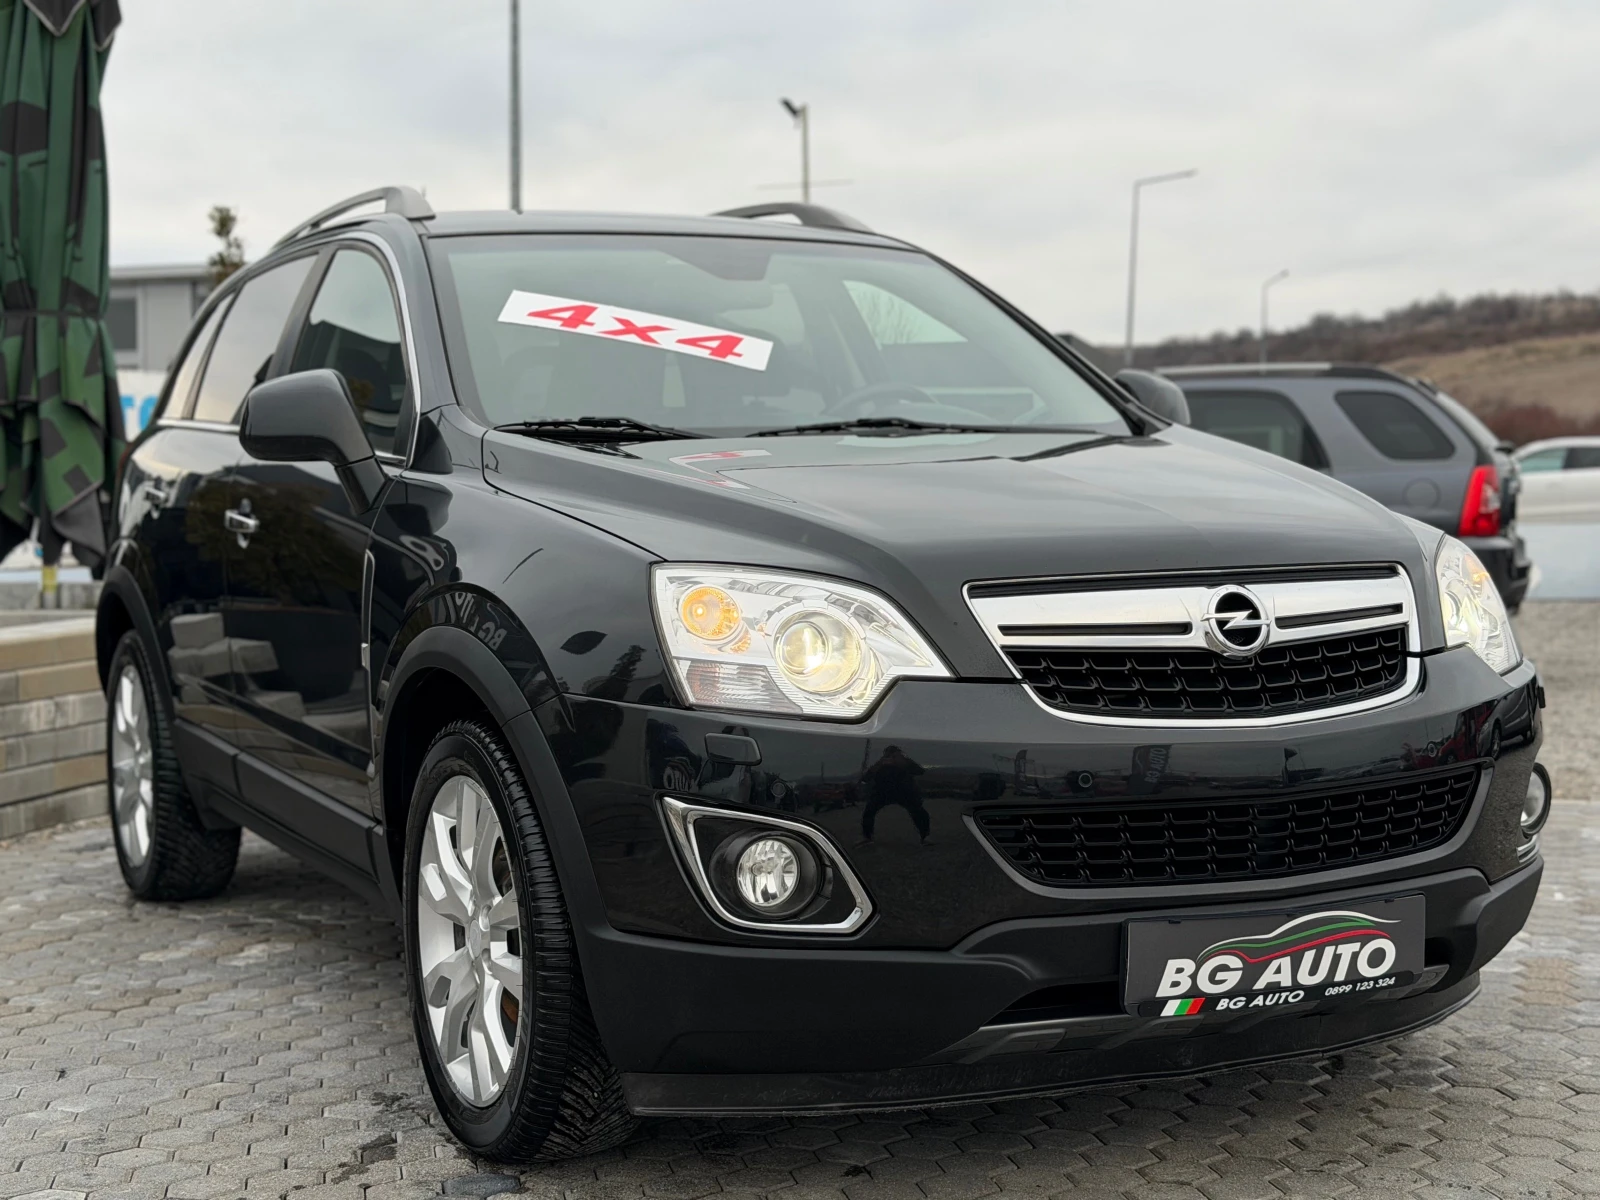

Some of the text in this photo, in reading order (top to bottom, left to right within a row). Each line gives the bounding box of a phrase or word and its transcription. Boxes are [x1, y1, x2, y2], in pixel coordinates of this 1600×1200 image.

[1155, 938, 1396, 998] BG AUTO
[1215, 976, 1396, 1011] BG AUTO 0899 123 324
